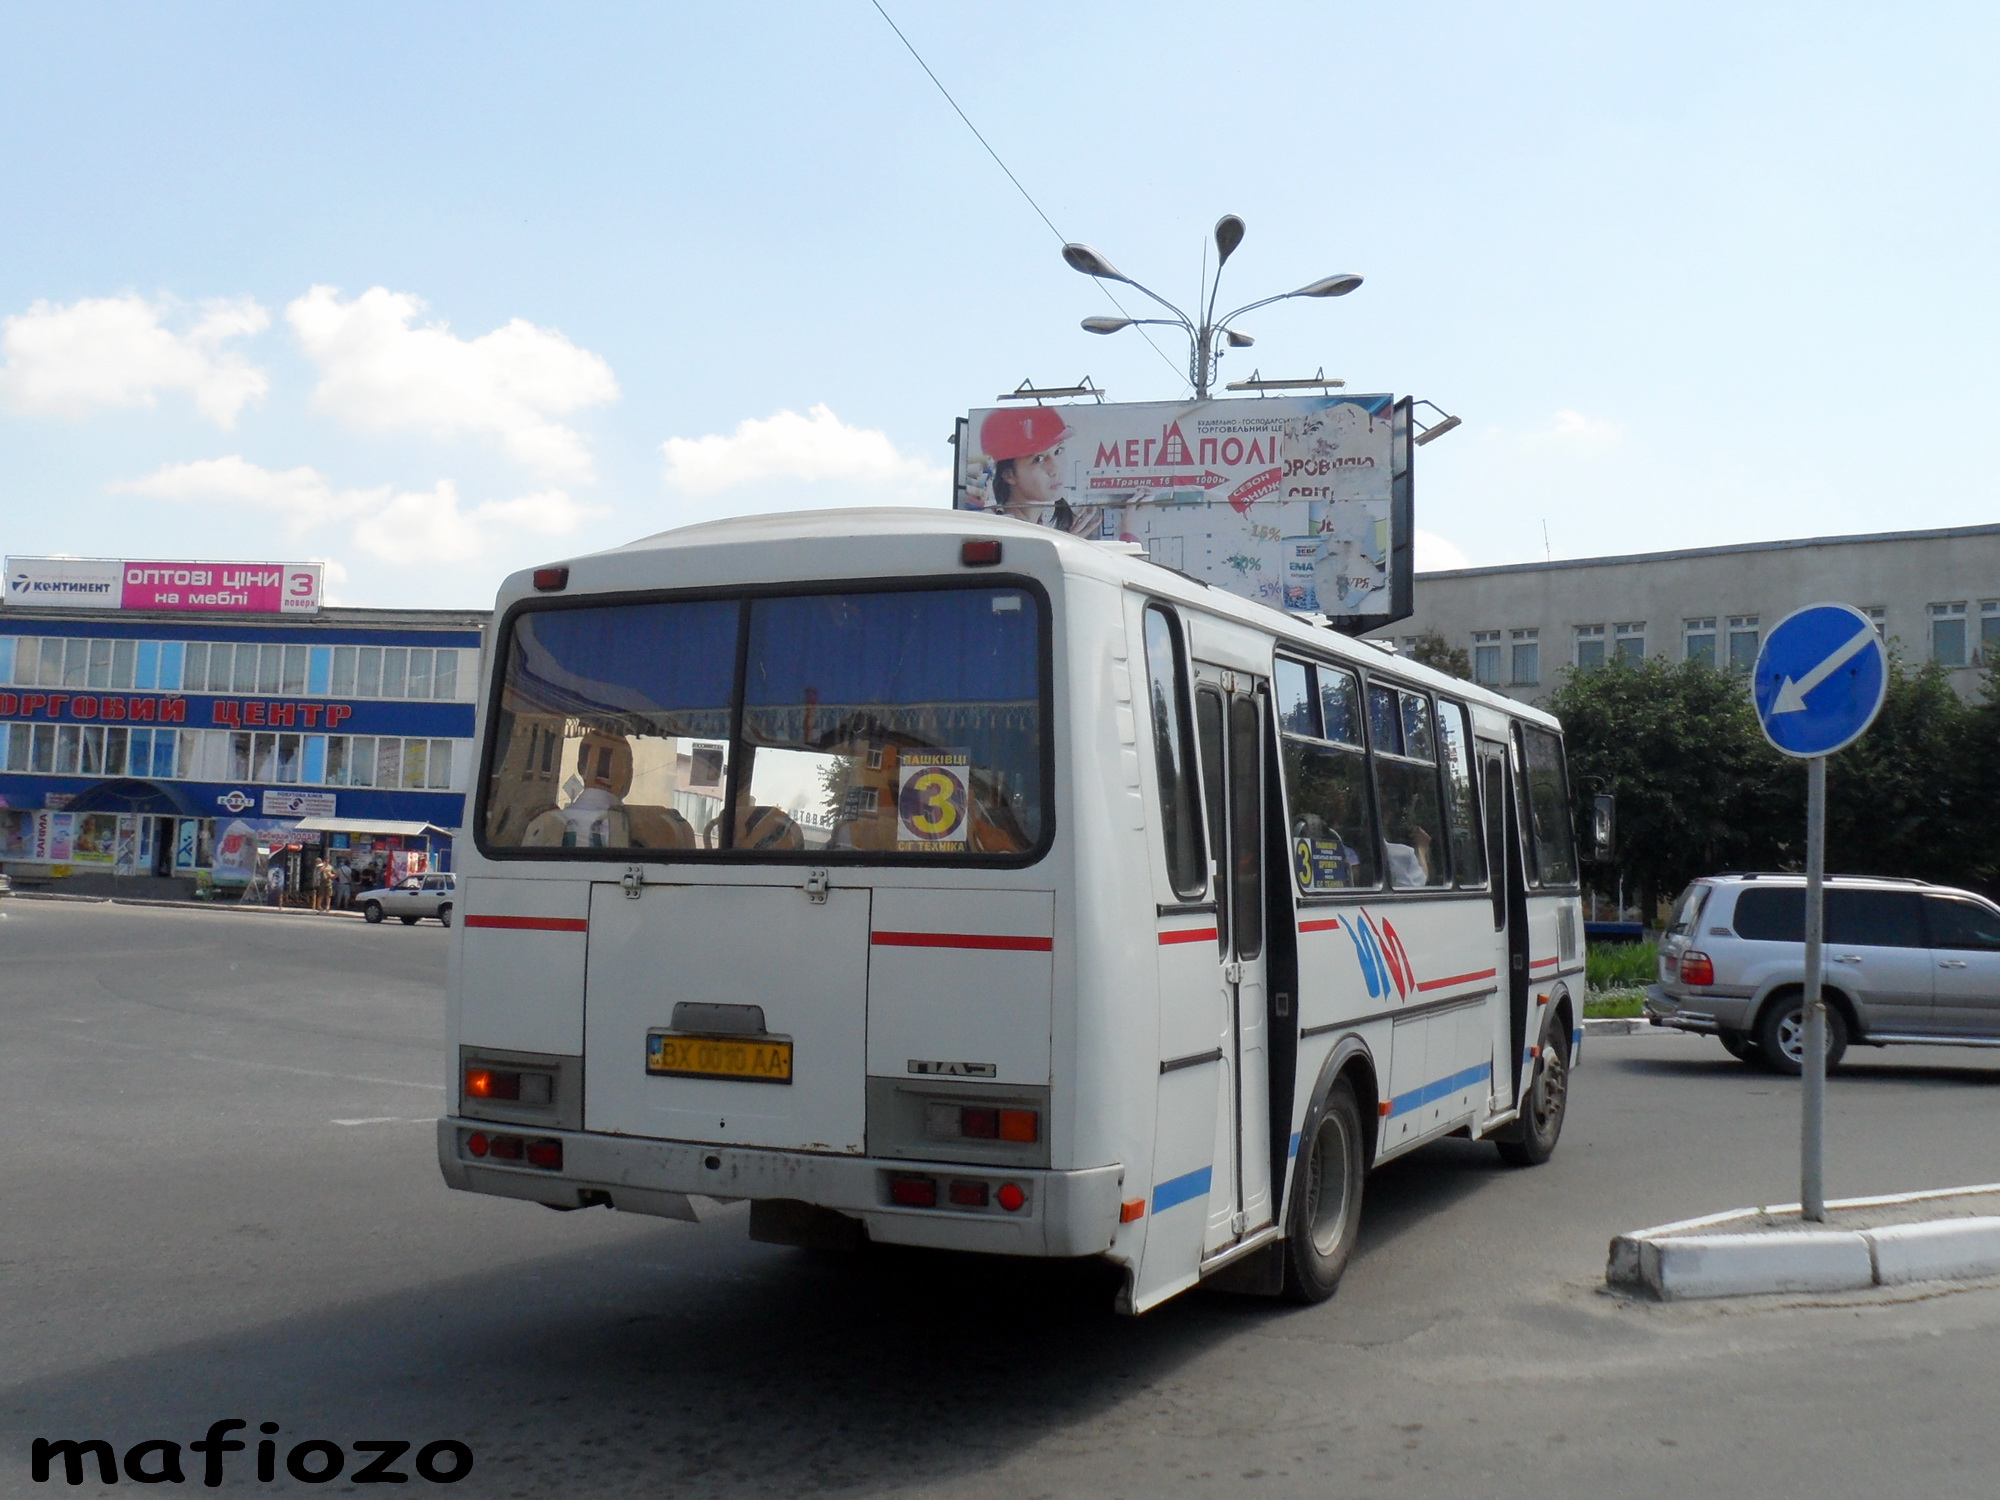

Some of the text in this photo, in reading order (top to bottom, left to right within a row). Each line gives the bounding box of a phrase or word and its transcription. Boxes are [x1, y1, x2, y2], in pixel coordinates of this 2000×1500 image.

[1197, 425, 1269, 434] ТОРГОВЕЛЬНИЙ
[1093, 420, 1282, 468] МЕГАПОЛІ
[1233, 473, 1270, 497] СЕЗОН
[33, 580, 111, 594] КОНТИНЕНТ
[126, 568, 281, 589] ОПТОВІ ЦІНИ
[289, 573, 313, 597] 3
[154, 591, 249, 606] на меблі
[284, 598, 316, 609] поверх
[211, 700, 352, 729] ЦЕНТР
[903, 754, 967, 766] ПАШКІВЦІ
[911, 773, 957, 834] 3
[36, 813, 48, 858] SARMA
[917, 841, 965, 852] ТЕХНІКА
[1297, 842, 1312, 885] 3
